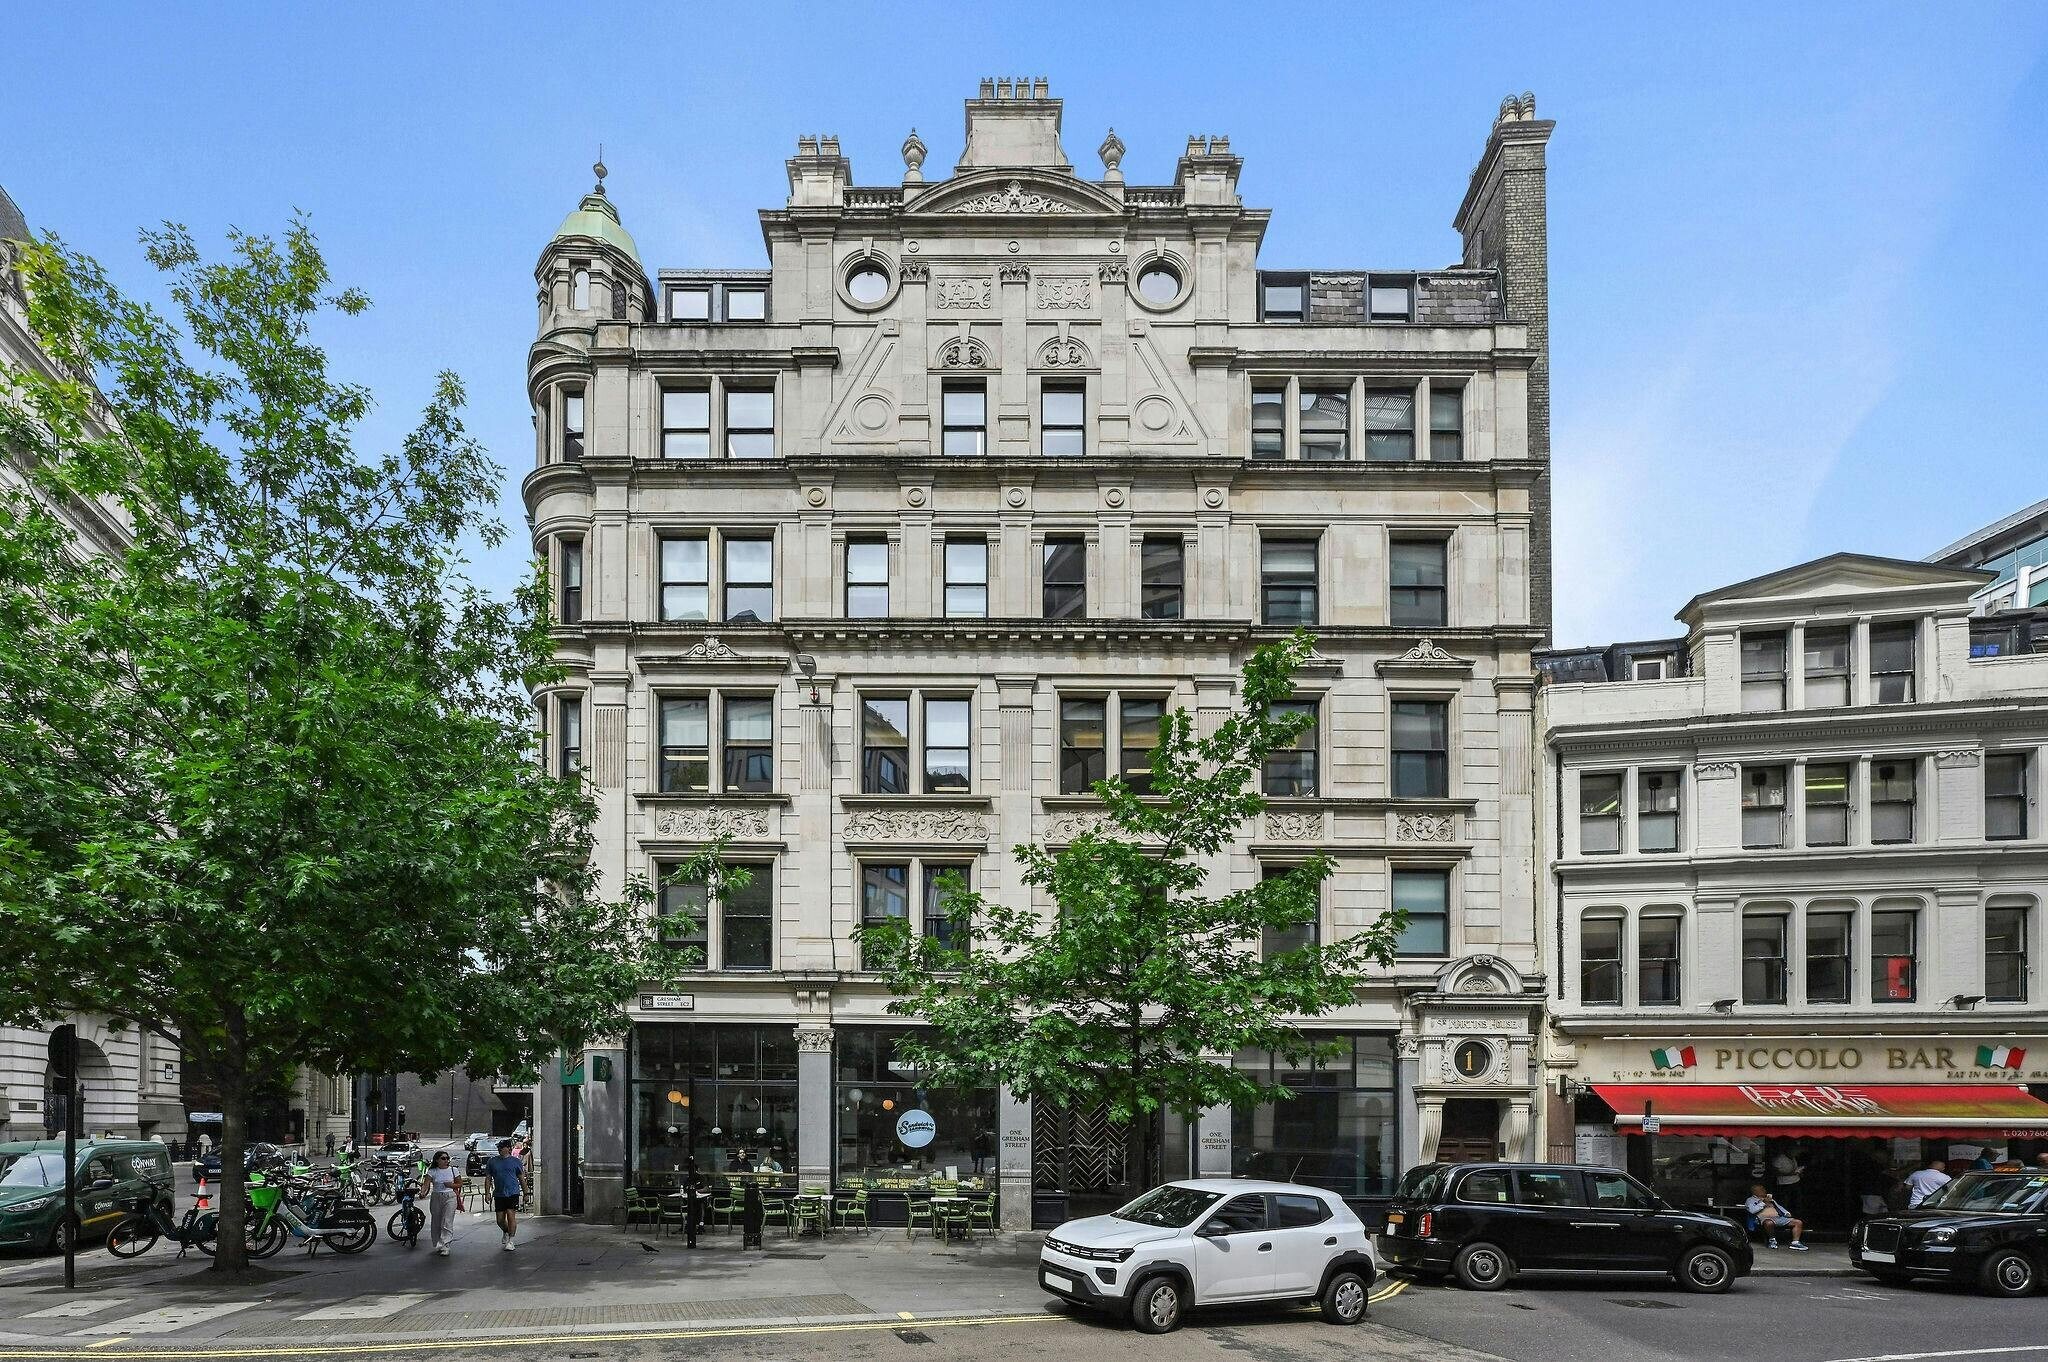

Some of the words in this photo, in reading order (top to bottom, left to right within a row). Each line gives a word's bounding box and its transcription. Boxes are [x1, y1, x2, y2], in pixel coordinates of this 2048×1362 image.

[1465, 1050, 1473, 1071] 1
[1715, 1048, 1863, 1070] PICCOLO
[1887, 1048, 1958, 1070] BAR
[132, 1158, 157, 1169] CONWAY
